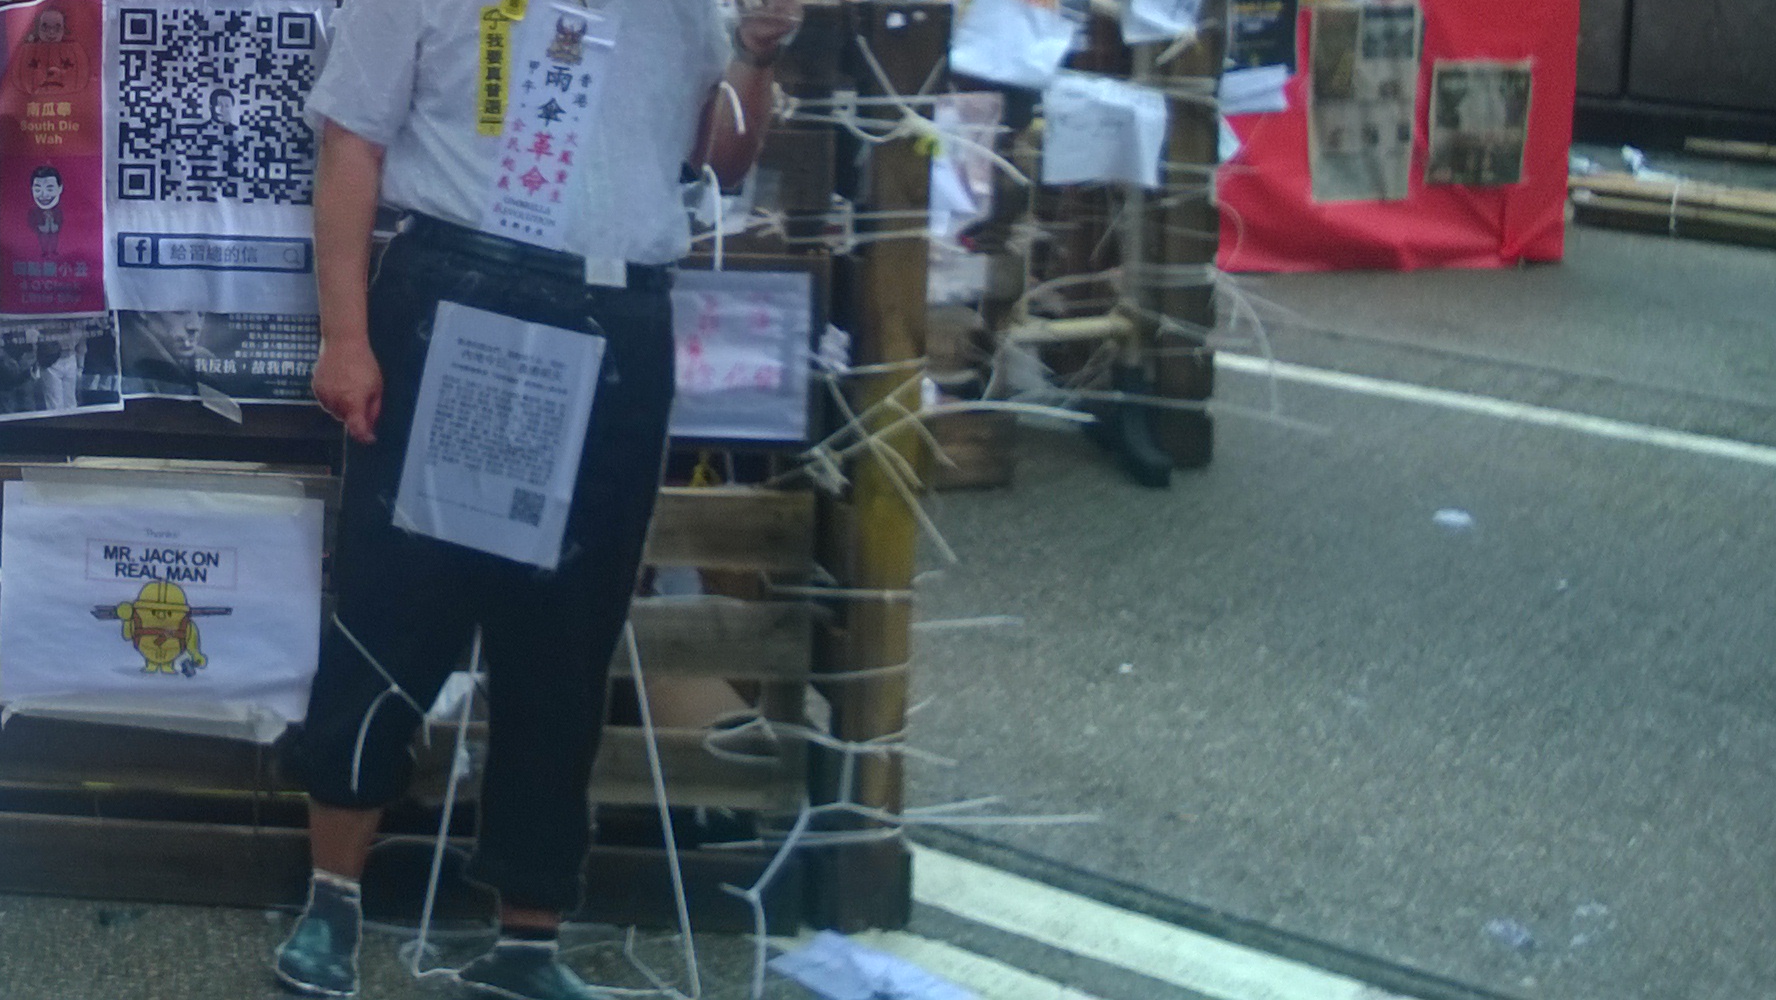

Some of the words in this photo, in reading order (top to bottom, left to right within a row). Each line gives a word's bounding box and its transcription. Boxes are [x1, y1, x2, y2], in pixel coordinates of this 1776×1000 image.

[58, 121, 80, 132] Die
[34, 133, 63, 145] Wah
[169, 243, 258, 264] 給習總的信
[104, 545, 135, 562] MR.
[139, 549, 187, 565] JACK
[192, 552, 219, 567] ON
[115, 562, 161, 579] REAL
[166, 565, 207, 583] MAN
